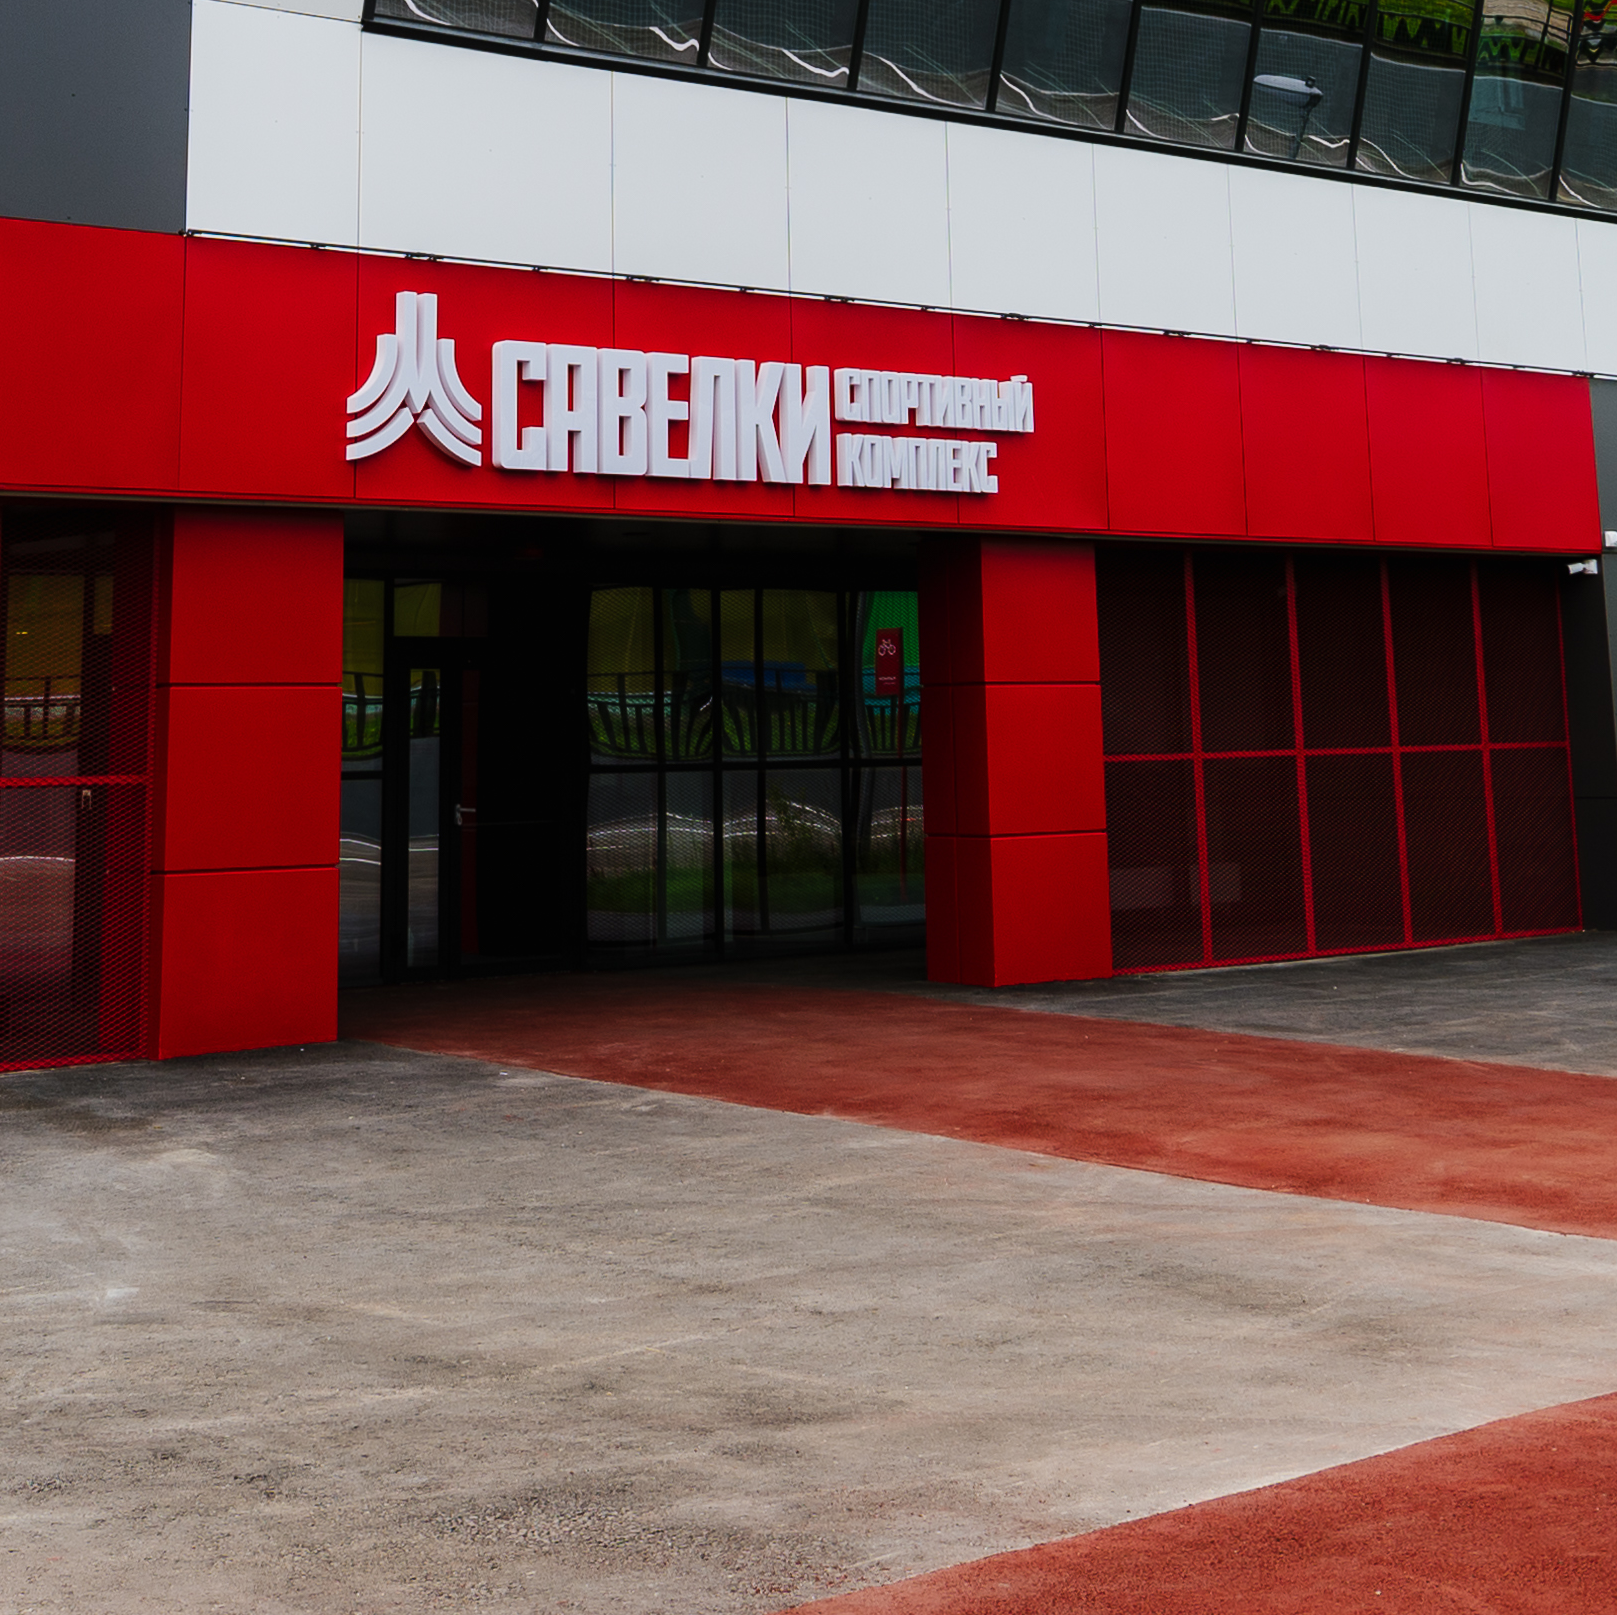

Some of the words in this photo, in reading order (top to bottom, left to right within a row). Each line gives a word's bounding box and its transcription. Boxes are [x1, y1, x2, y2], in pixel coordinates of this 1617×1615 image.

[492, 340, 831, 485] САВЕЛКИ
[834, 368, 1034, 433] СПОРТИВНЫЙ
[836, 432, 998, 493] КОМПЛЕКС
